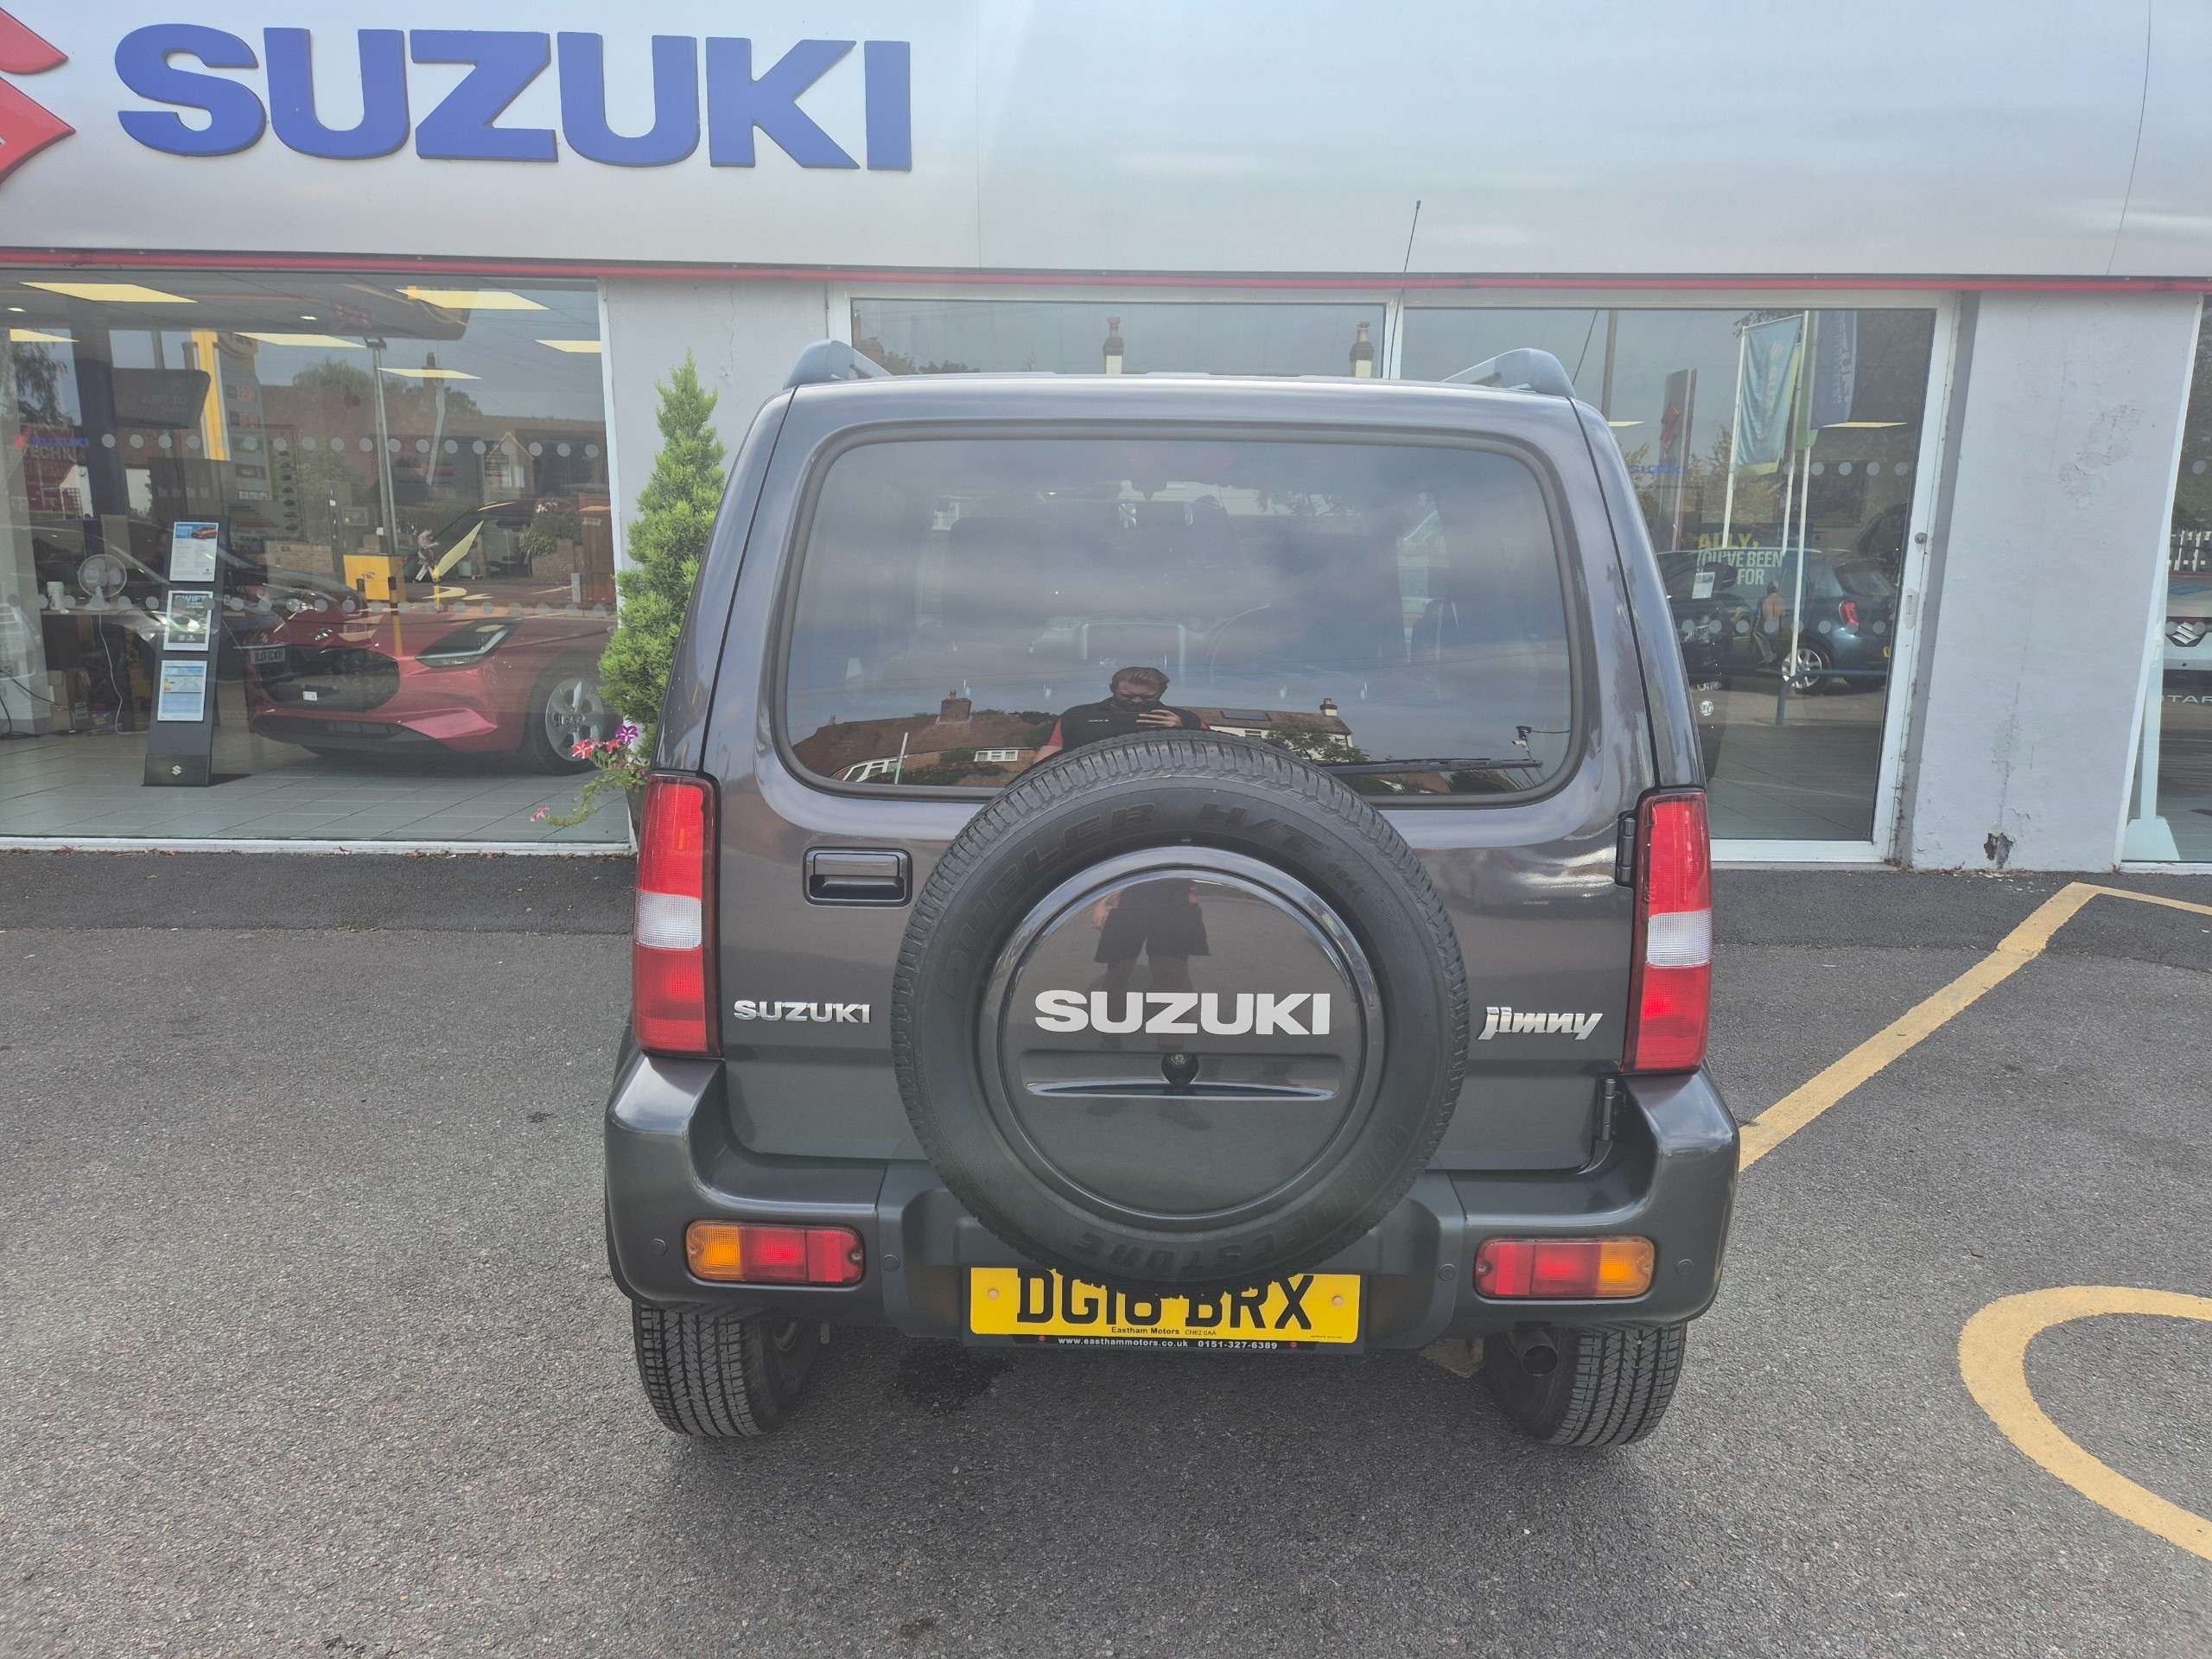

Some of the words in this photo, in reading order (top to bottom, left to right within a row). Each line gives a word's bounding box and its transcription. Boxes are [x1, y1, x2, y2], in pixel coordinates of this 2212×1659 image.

[114, 22, 912, 172] SUZUKI
[1701, 550, 1744, 567] OU'VE
[1745, 551, 1784, 568] BEEN
[1737, 569, 1764, 586] FOR
[733, 1000, 871, 1024] SUZUKI
[1034, 989, 1331, 1035] SUZUKI
[1477, 1006, 1605, 1040] jimny
[1111, 1326, 1148, 1335] Eastham
[1150, 1327, 1180, 1336] Motors
[1058, 1337, 1189, 1348] www.easthammotors.co.uk
[1198, 1339, 1278, 1350] 0151-327-6389
